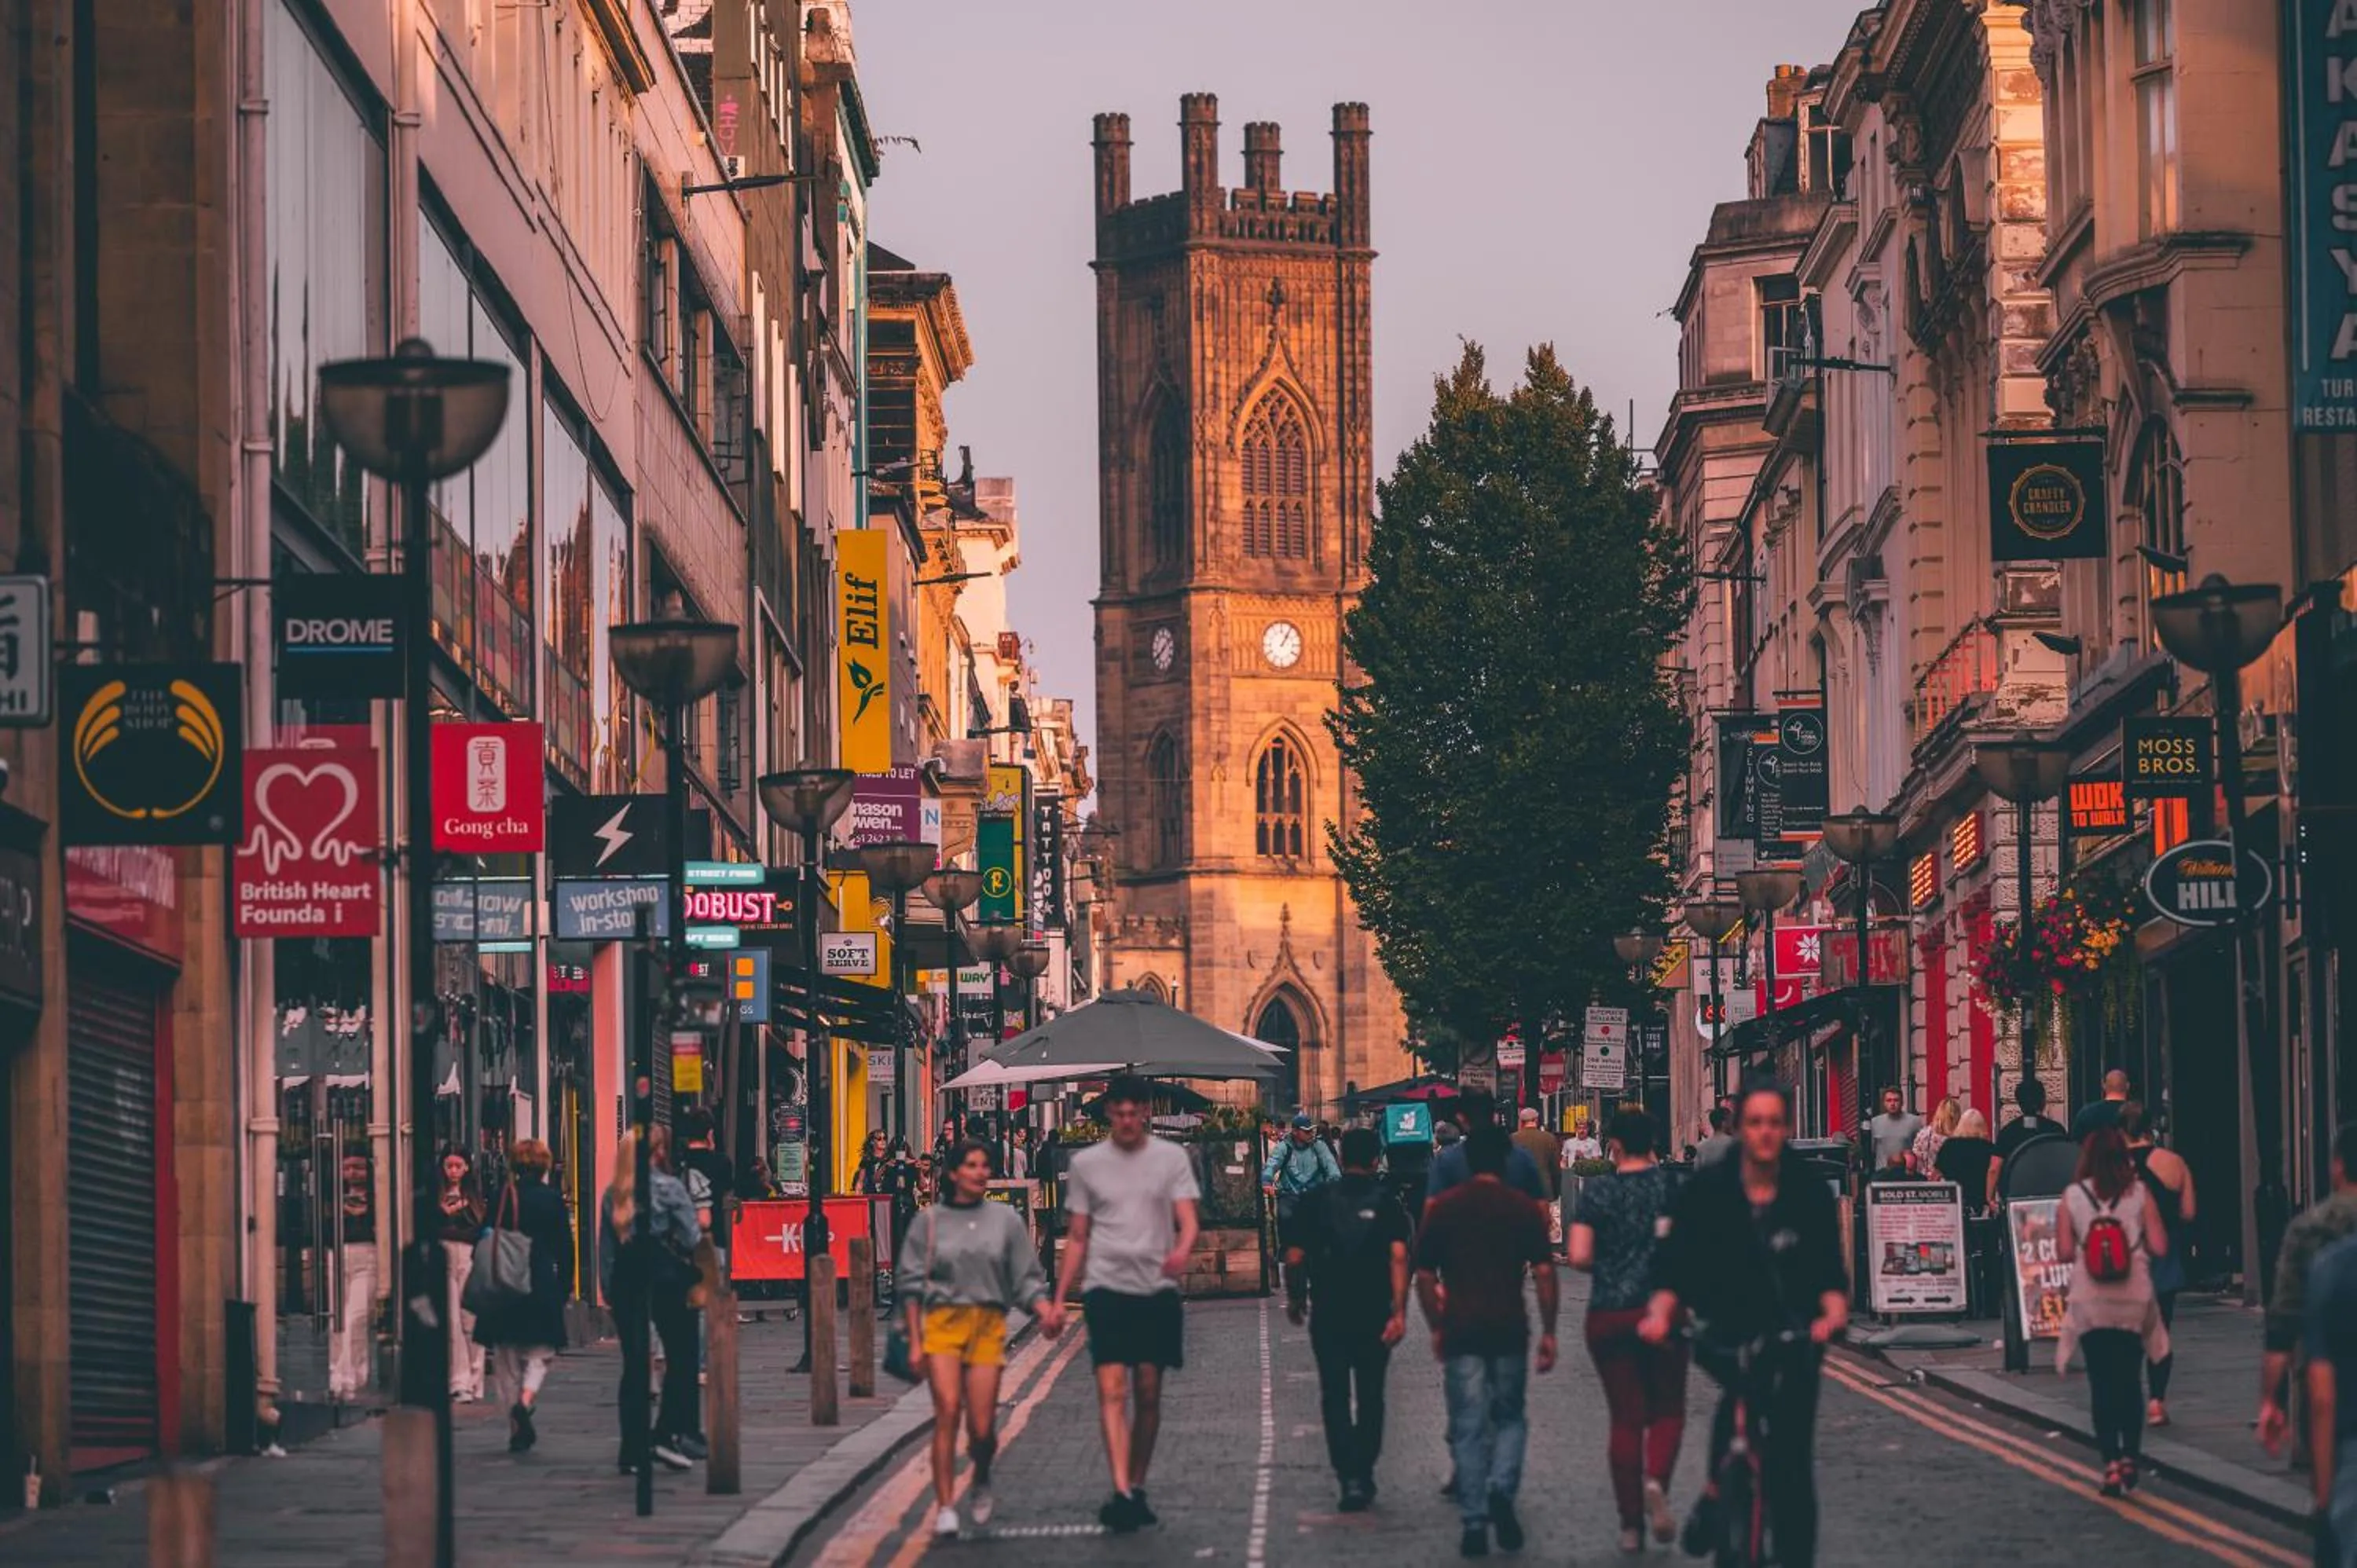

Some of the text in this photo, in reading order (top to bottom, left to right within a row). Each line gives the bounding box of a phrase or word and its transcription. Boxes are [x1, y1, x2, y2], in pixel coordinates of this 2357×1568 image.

[845, 571, 878, 650] Elif
[286, 618, 393, 643] DROME
[2137, 738, 2196, 754] MOSS
[898, 768, 916, 779] LET
[2138, 757, 2201, 774] BROS.
[1745, 747, 1754, 822] SLIMMING
[2069, 781, 2125, 810] WOK
[444, 816, 529, 838] Gong cha
[2072, 810, 2125, 827] TO WALK
[1040, 805, 1053, 897] TATTOO
[240, 881, 372, 901] British Heart
[826, 958, 870, 967] SERVE
[827, 947, 869, 959] SOFT
